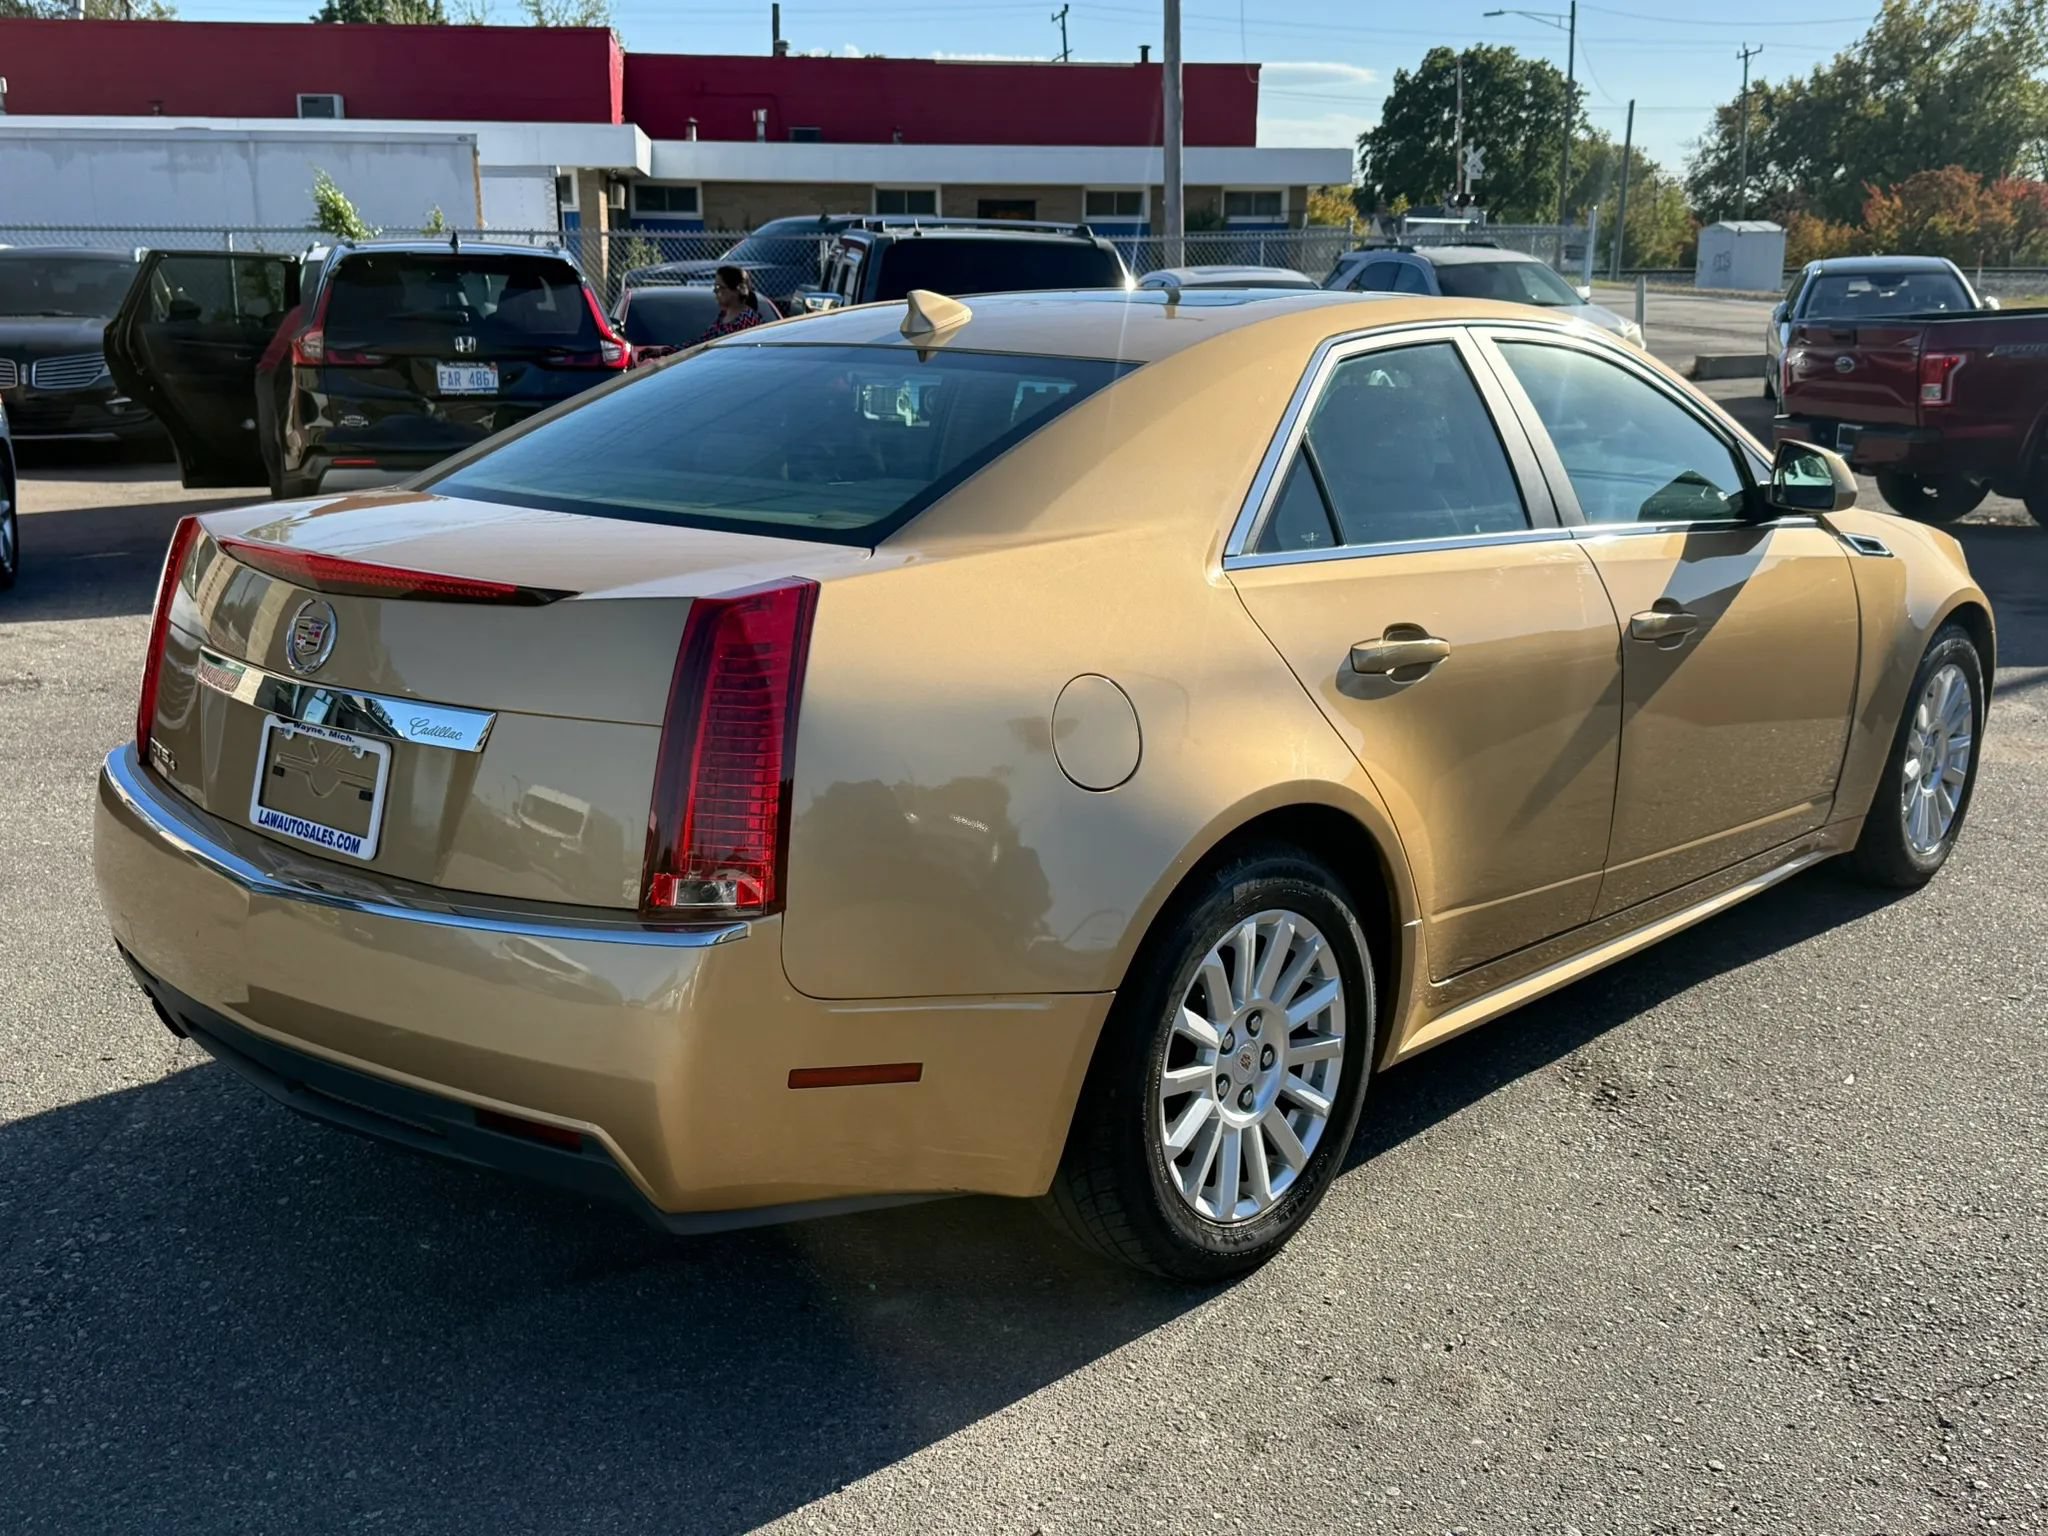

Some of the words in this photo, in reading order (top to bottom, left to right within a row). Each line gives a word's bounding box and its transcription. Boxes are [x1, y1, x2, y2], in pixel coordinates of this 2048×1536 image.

[440, 371, 461, 386] FAR
[469, 371, 497, 386] 4867
[294, 722, 326, 736] Wayne,
[329, 730, 355, 743] Mich.
[410, 717, 463, 740] Cadillac
[258, 809, 361, 854] LAWAUTOSALES.COM
